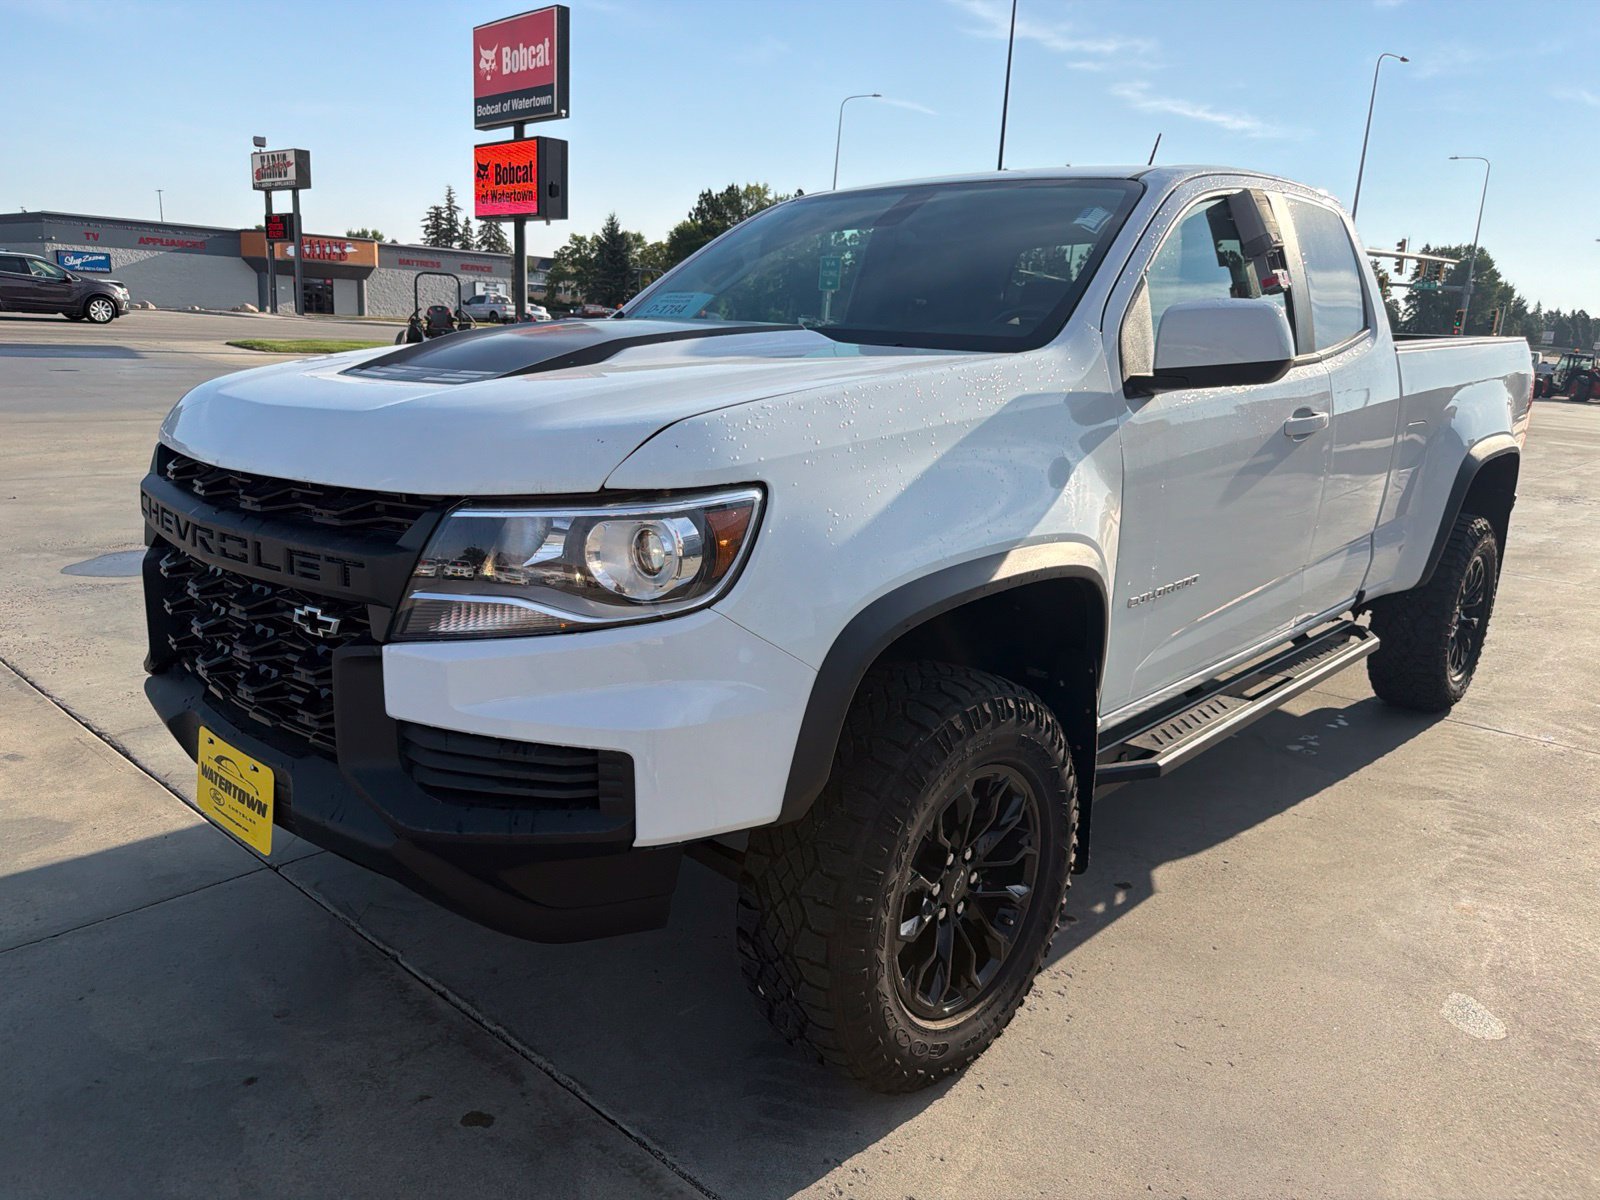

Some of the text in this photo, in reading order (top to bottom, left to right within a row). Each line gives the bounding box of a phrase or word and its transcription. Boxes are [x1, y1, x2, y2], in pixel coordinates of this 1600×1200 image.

[502, 37, 550, 75] Bobcat
[476, 94, 552, 117] Bobcat of Watertown
[481, 160, 534, 204] Bobcat of Watertown
[84, 232, 99, 242] TV
[138, 237, 206, 250] APPLIANCES
[398, 258, 441, 269] MATTRESS
[460, 263, 493, 272] SERVICE
[140, 491, 365, 588] CHEVROLET
[1126, 573, 1200, 609] COLORADO
[201, 761, 268, 819] WATERTOWN
